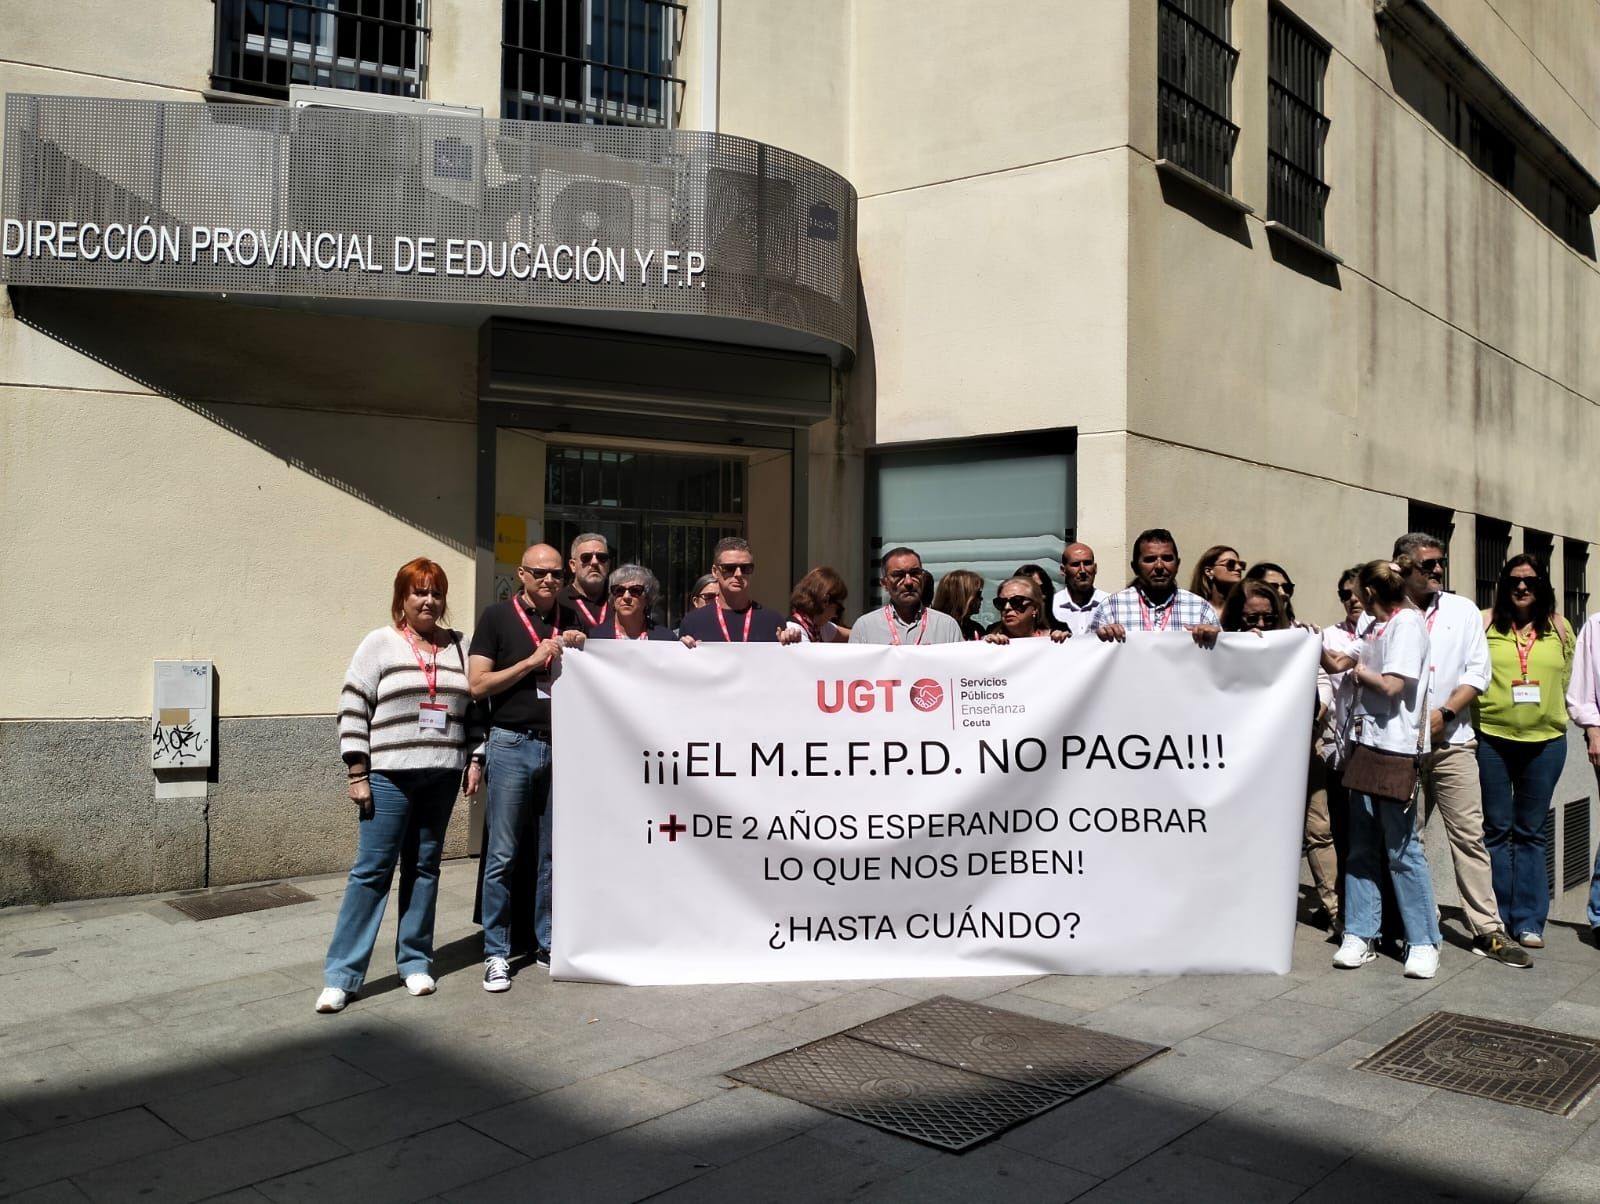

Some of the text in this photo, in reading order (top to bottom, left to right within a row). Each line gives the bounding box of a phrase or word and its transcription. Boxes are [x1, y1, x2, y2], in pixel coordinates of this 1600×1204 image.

[2, 216, 707, 288] DIRECCIÓN PROVINCIAL DE EDUCACIÓN Y F.P.
[817, 679, 902, 714] UGT
[960, 677, 1008, 688] Servicios
[961, 690, 1005, 701] Públicos
[961, 703, 1026, 716] Enseñanza
[962, 718, 991, 728] Ceuta
[642, 733, 1226, 786] ¡¡¡EL M.E.F.P.D. NO PAGA!!!
[692, 813, 733, 840] DE
[741, 816, 760, 841] 2
[766, 809, 858, 841] AÑOS
[867, 808, 1059, 841] ESPERANDO
[1068, 807, 1208, 834] COBRAR
[764, 849, 1084, 886] LO QUE NOS DEBEN!
[768, 904, 1081, 950] ¿HASTA CUÁNDO?
